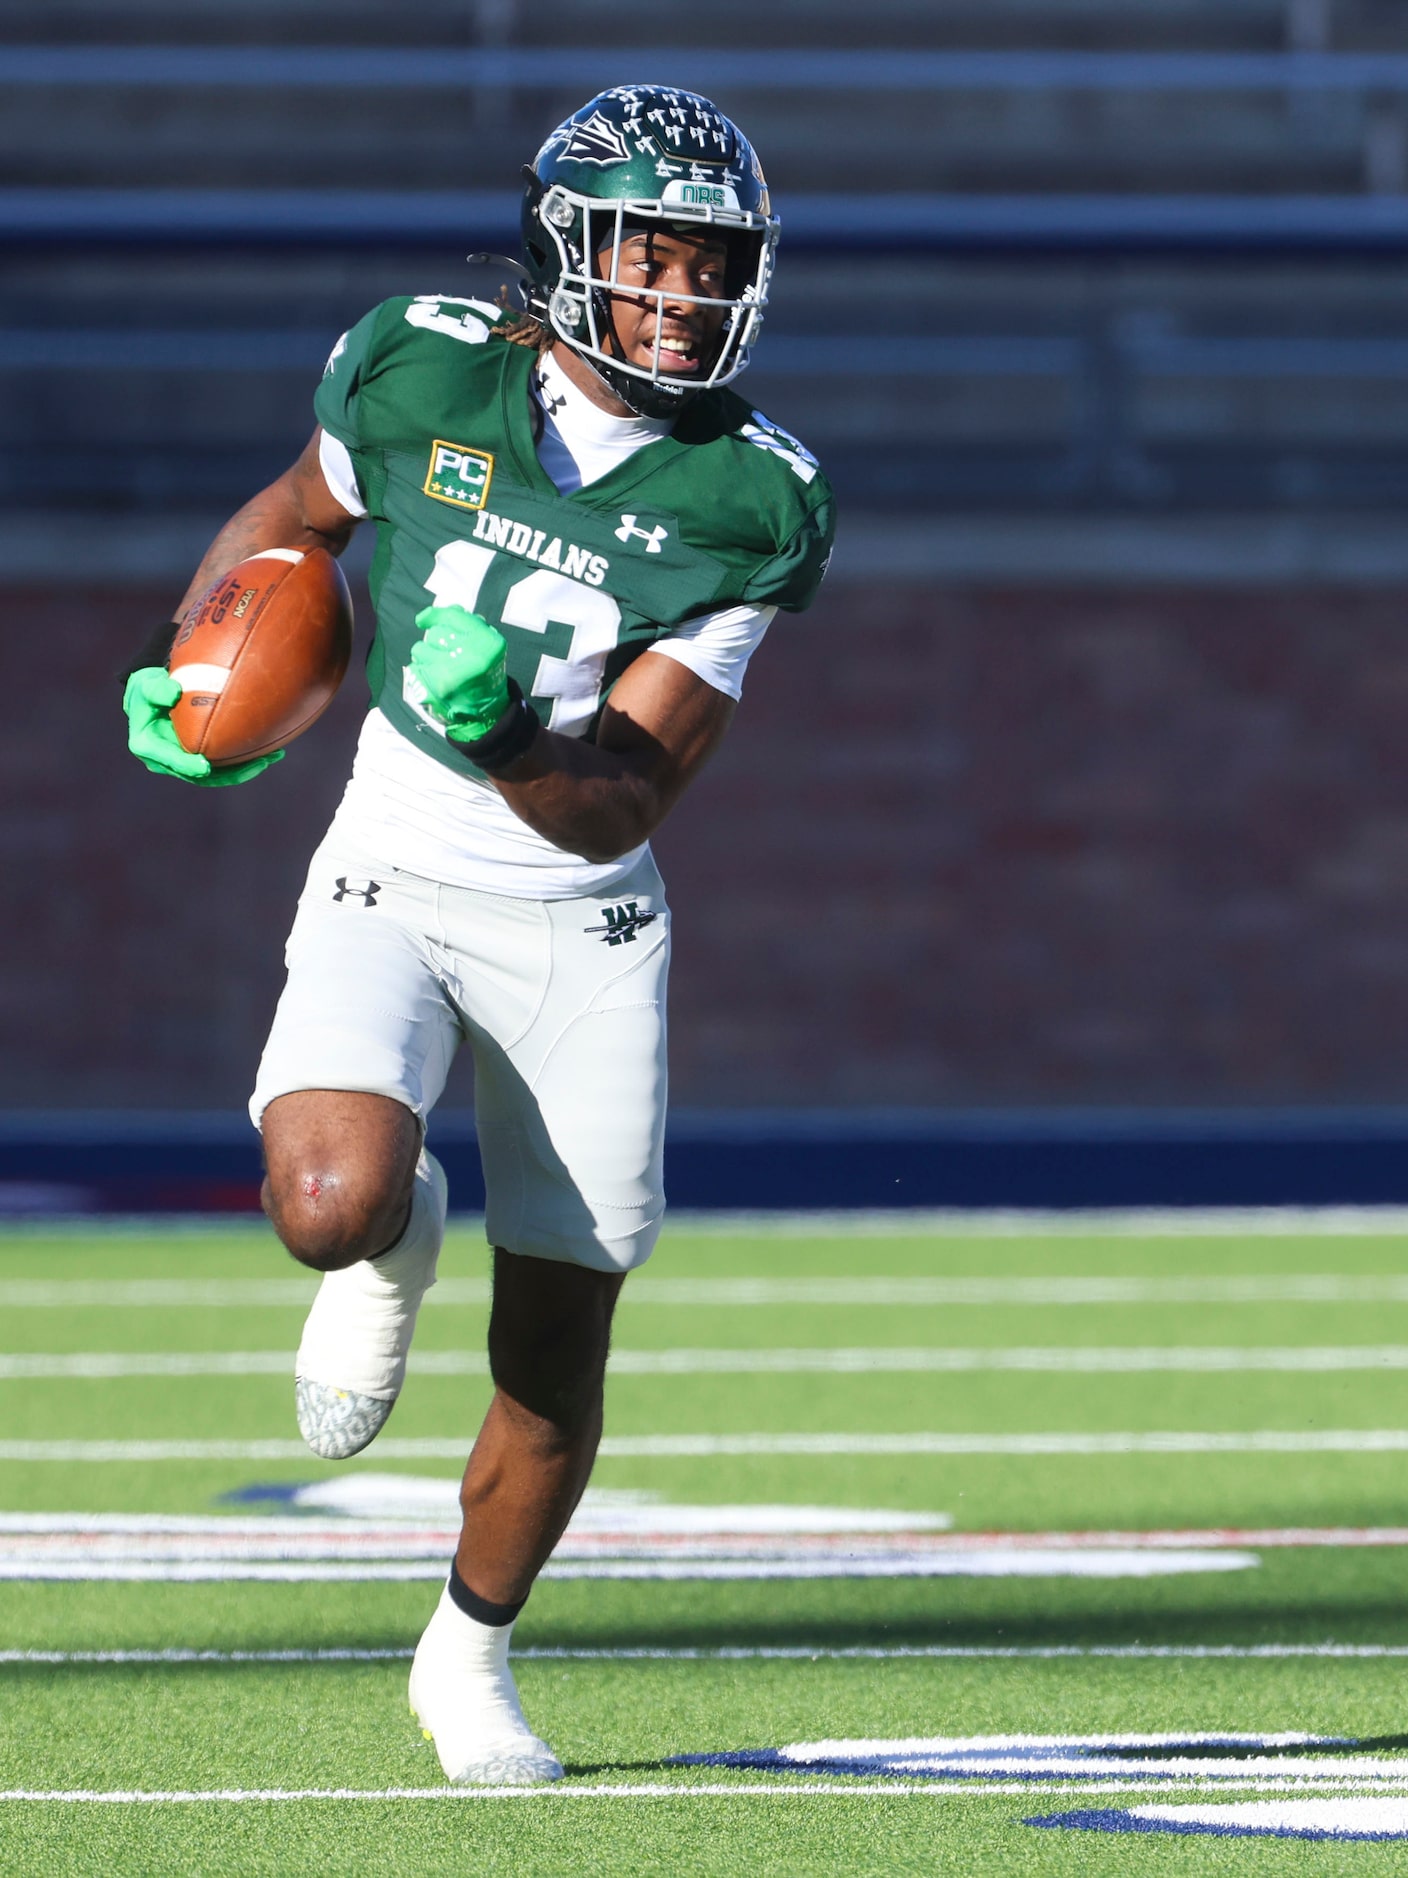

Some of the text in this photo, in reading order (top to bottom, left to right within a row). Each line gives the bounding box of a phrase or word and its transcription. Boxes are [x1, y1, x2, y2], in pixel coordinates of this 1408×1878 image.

[434, 446, 488, 486] PC
[472, 510, 609, 586] INDIANS
[232, 588, 258, 619] NCAA
[402, 540, 622, 738] 13
